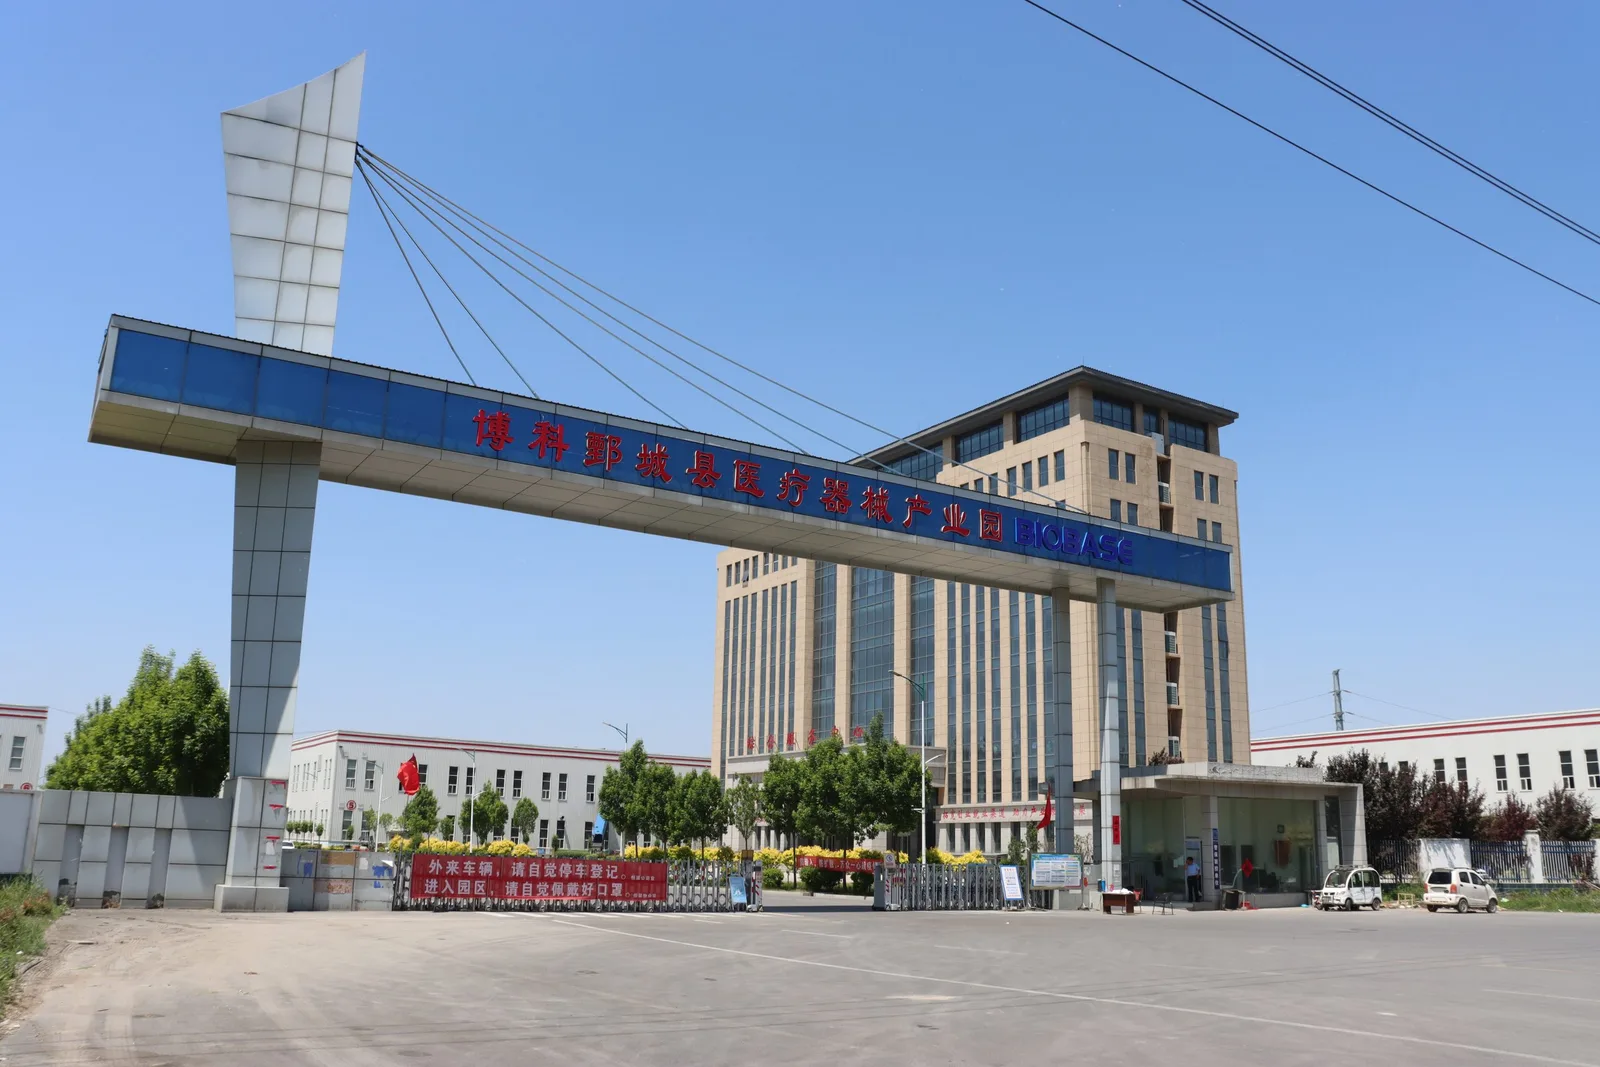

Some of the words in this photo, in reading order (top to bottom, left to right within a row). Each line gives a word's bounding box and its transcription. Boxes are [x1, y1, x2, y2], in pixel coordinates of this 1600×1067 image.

[473, 409, 1003, 542] 博科鄄城县医疗器械产业园
[1014, 517, 1133, 566] BIOBASE
